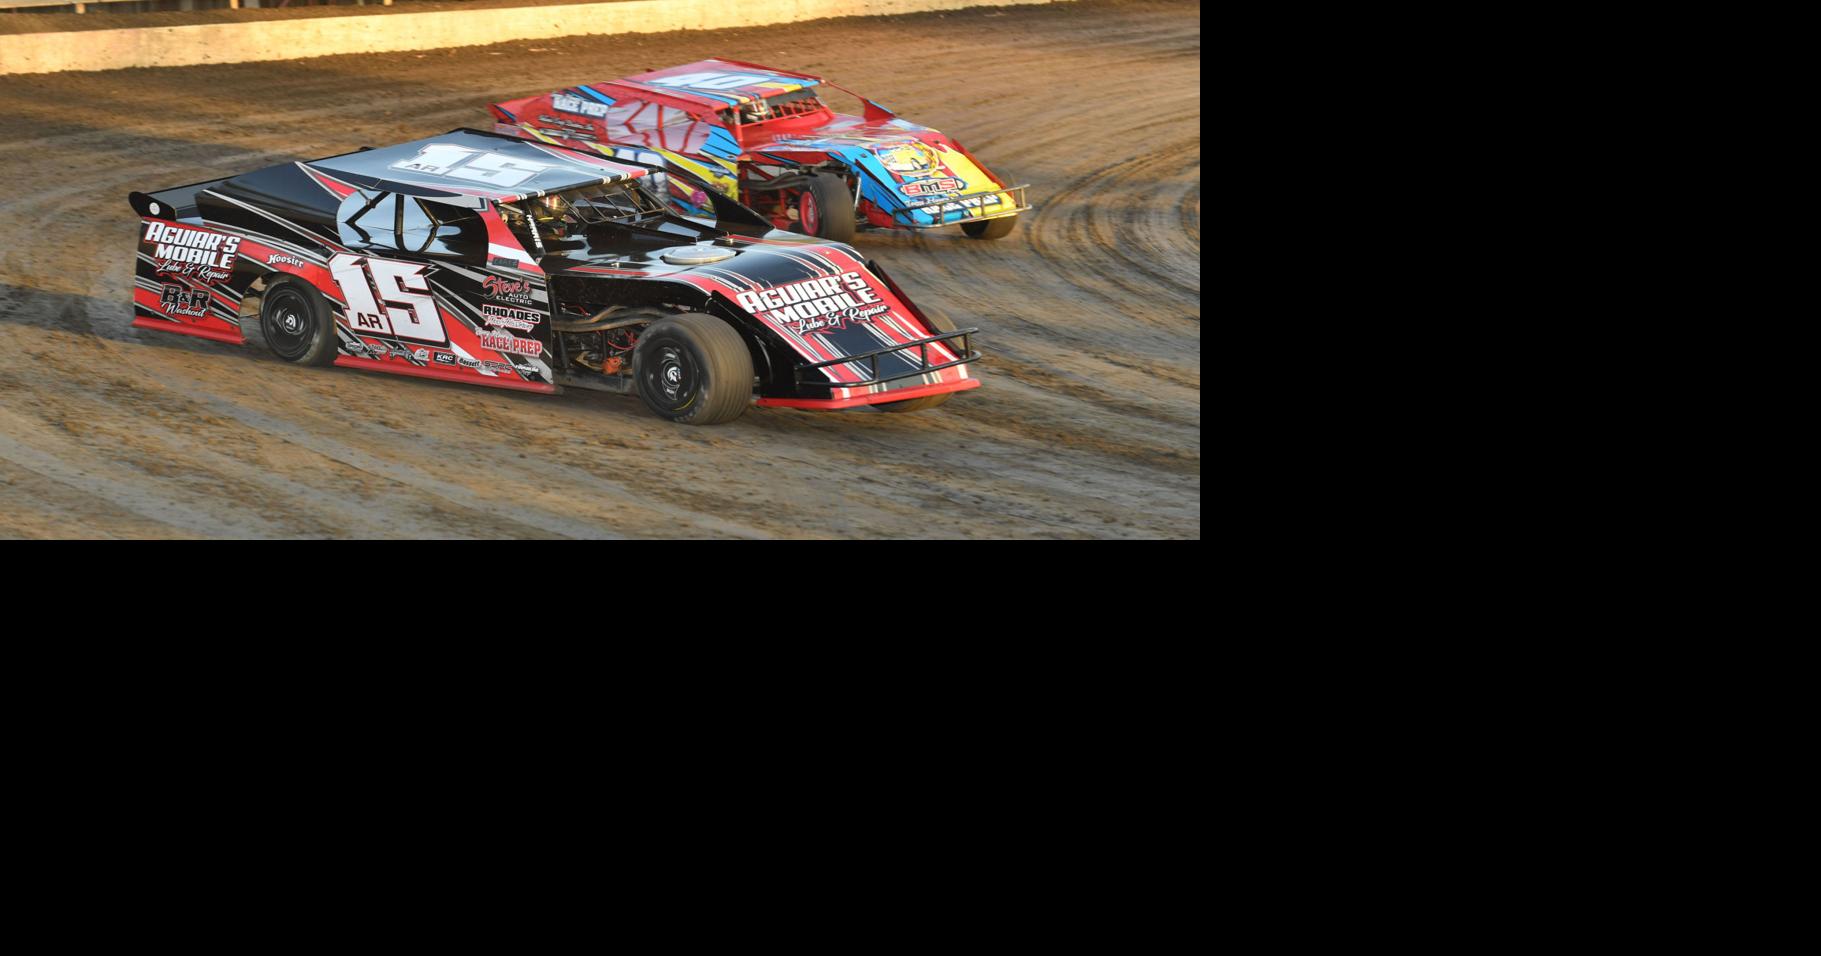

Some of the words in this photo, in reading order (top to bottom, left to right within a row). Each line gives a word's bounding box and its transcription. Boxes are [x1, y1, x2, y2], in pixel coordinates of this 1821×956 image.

[389, 143, 557, 188] 15
[405, 163, 438, 173] AR
[145, 221, 241, 254] AGUIAR'S
[155, 244, 236, 269] MOBILE
[267, 253, 304, 268] Hoosier
[157, 259, 181, 273] Lube
[197, 265, 229, 283] Repair
[482, 276, 532, 299] Steve's
[736, 272, 867, 314] AGUIAR'S
[161, 302, 206, 317] Washout
[327, 252, 449, 349] 15
[495, 295, 533, 305] ELECTRIC
[770, 287, 881, 324] MOBILE
[357, 312, 383, 330] AR
[483, 305, 540, 323] RHOADES
[798, 318, 826, 334] Lube
[842, 304, 888, 321] Repair
[482, 335, 510, 351] RACE
[513, 337, 541, 355] PREP
